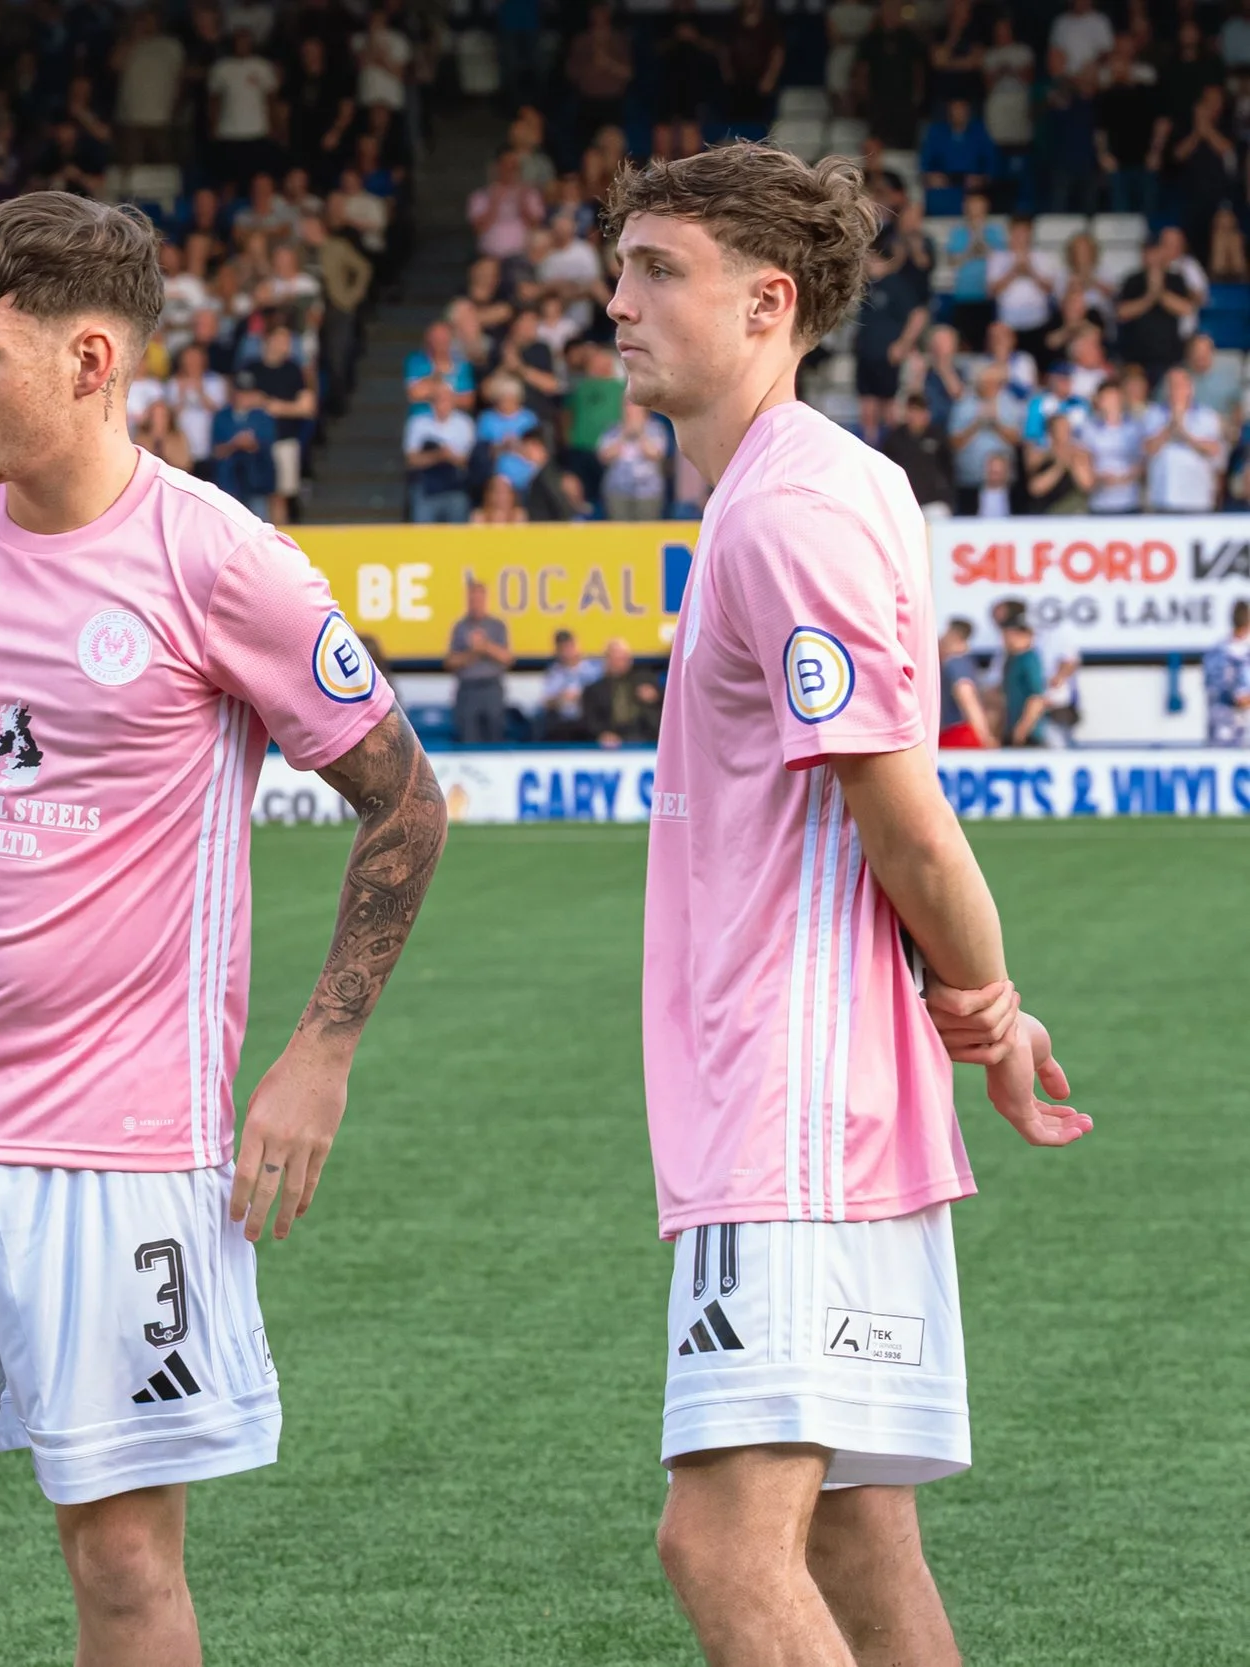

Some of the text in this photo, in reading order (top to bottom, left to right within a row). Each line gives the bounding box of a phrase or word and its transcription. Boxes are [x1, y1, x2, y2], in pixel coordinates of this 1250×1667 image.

[951, 539, 1250, 584] SALFORD VA
[357, 563, 433, 621] BE
[464, 565, 646, 615] OCAL
[797, 658, 825, 695] B
[14, 798, 100, 831] STEELS
[517, 769, 622, 823] GARY
[134, 1237, 190, 1349] 3
[872, 1329, 893, 1341] TEK
